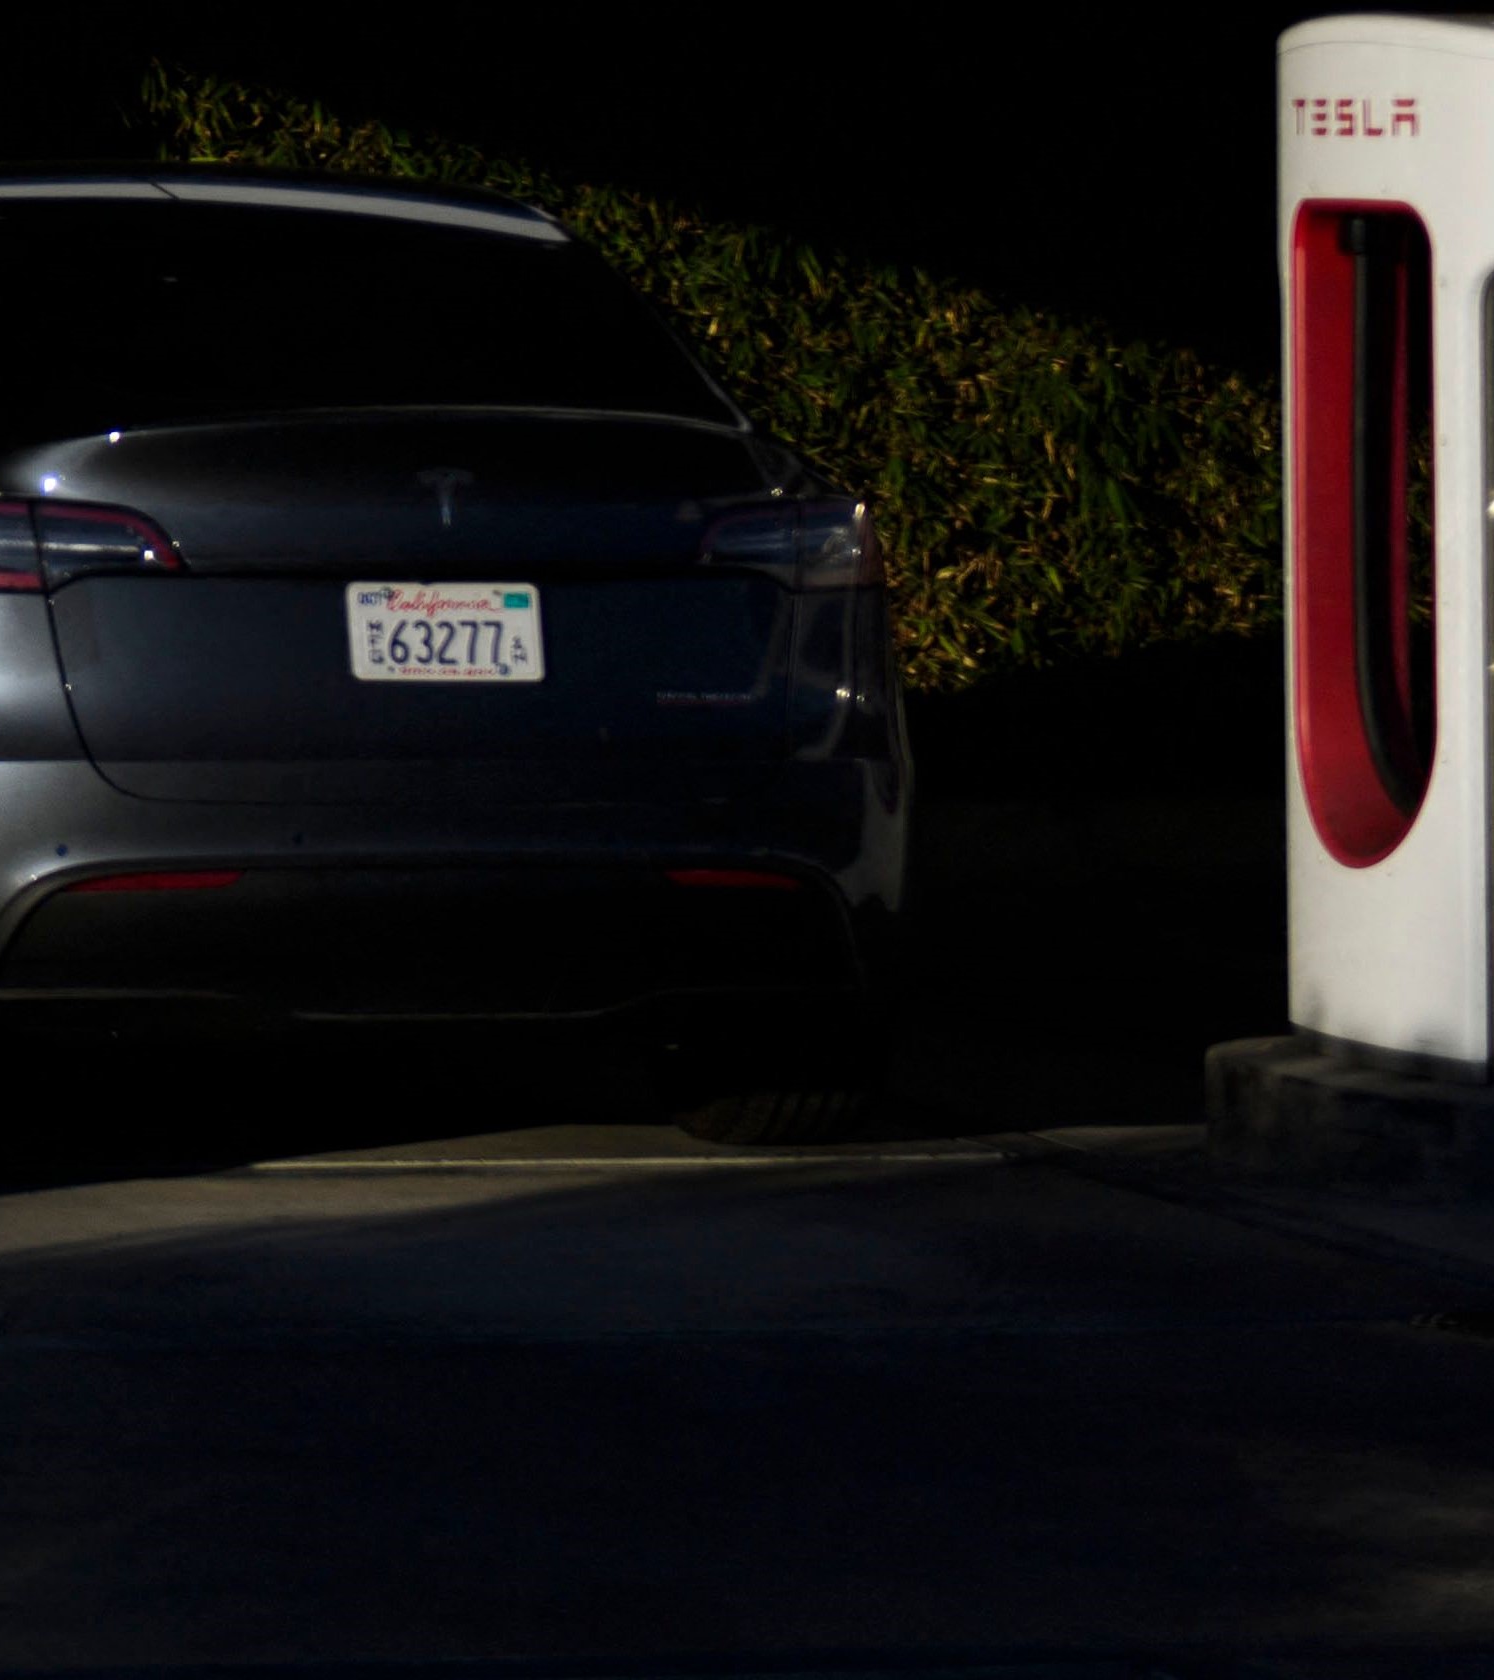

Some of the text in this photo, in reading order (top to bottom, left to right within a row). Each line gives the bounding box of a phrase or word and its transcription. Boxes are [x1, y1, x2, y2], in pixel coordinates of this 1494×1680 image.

[1292, 98, 1420, 137] TESLA
[386, 588, 504, 618] California
[389, 619, 504, 666] 63277
